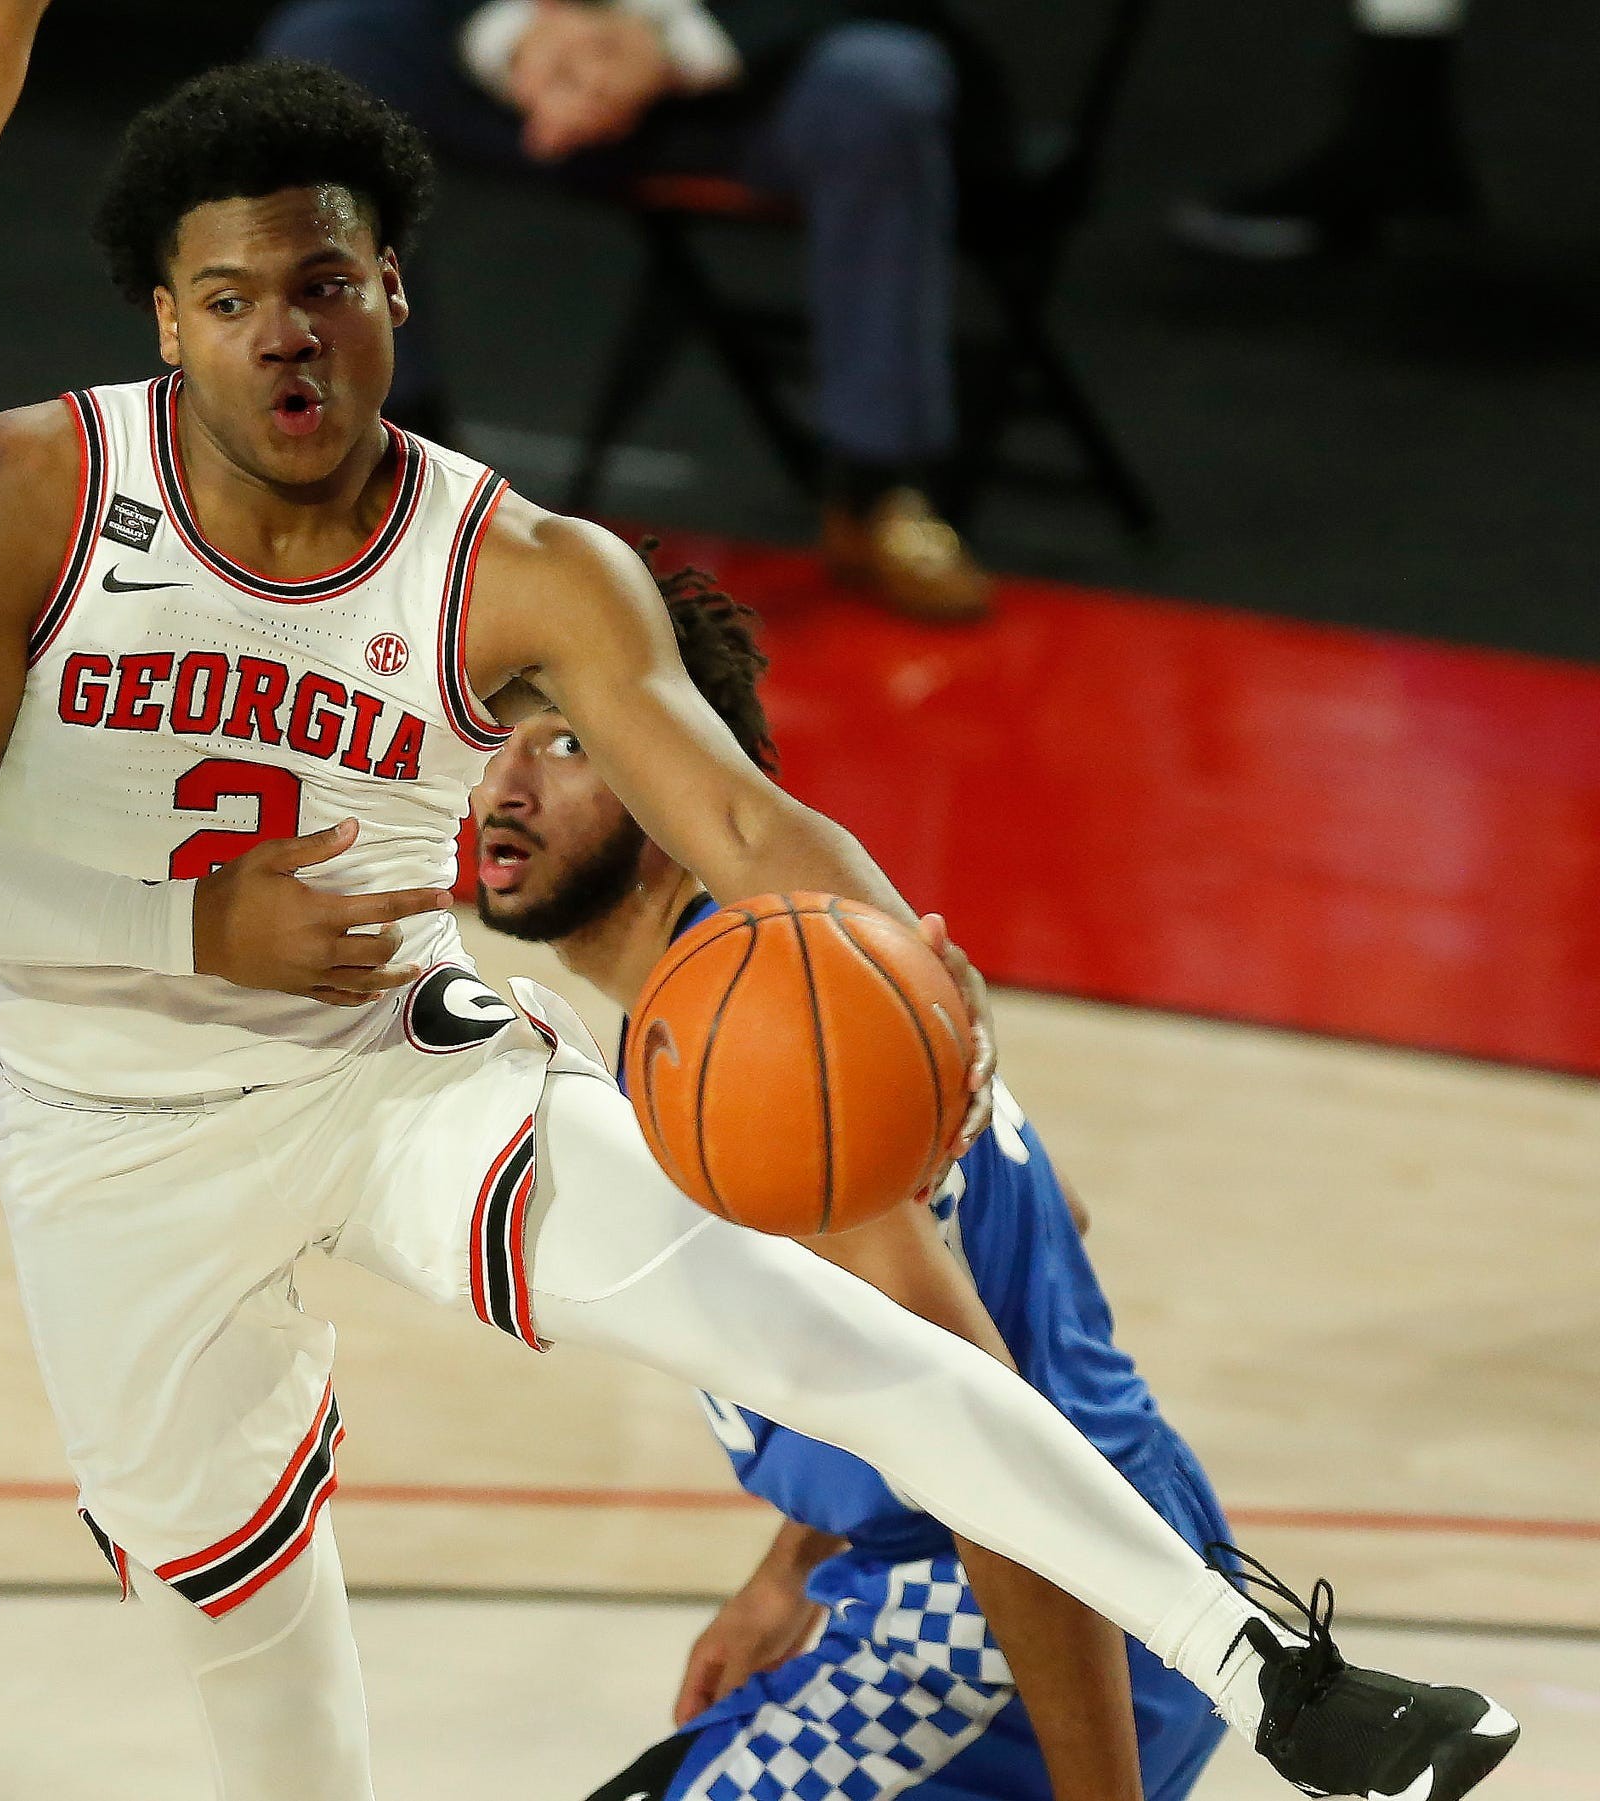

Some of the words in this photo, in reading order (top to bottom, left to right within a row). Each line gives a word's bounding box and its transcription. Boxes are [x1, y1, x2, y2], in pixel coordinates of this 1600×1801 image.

[57, 651, 427, 781] GEORGIA
[369, 637, 405, 672] SEC
[168, 757, 302, 883] 2
